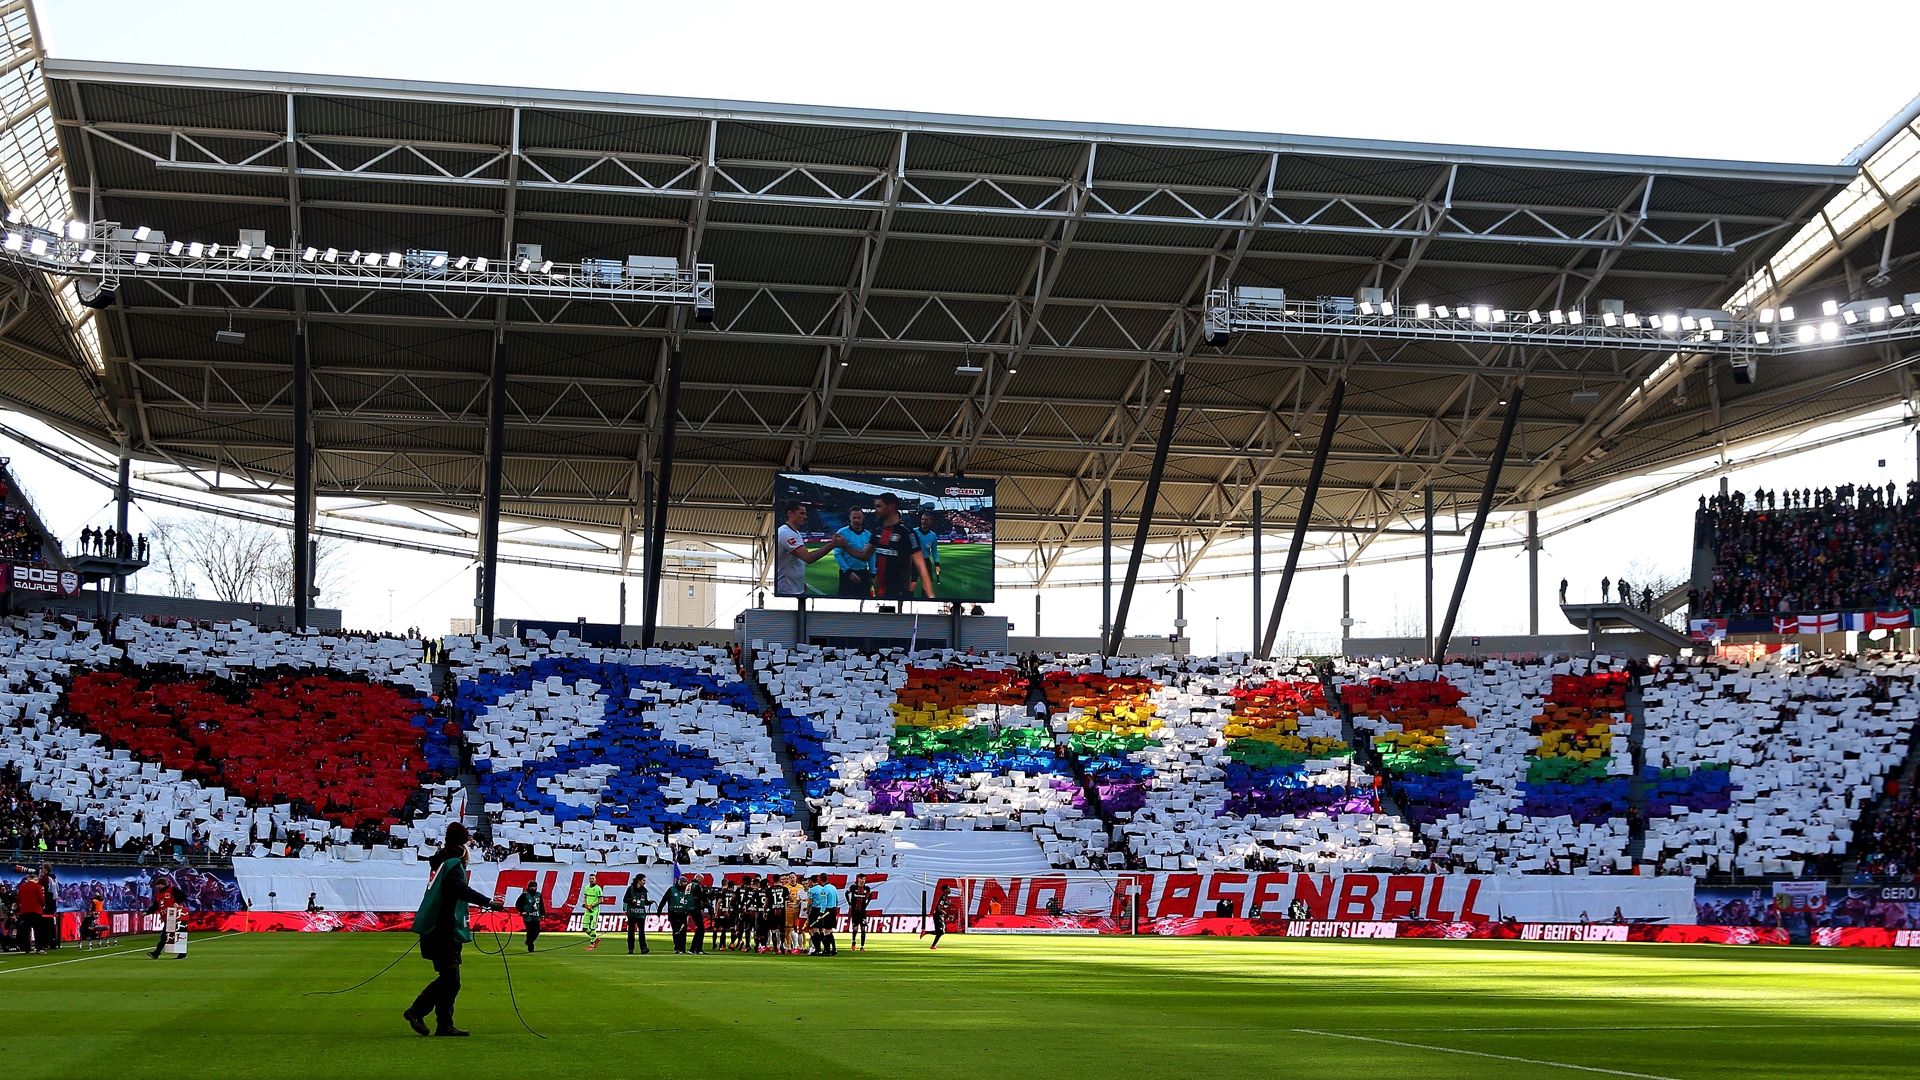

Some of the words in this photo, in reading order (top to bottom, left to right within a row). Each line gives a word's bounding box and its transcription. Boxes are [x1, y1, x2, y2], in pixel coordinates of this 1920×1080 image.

[13, 566, 58, 583] BOS
[14, 581, 58, 593] GAURUS
[466, 870, 630, 912] OVE
[1111, 873, 1490, 922] RASENBALL
[772, 892, 784, 904] 13
[1881, 887, 1917, 900] GERO
[1287, 921, 1310, 937] AUF
[1310, 921, 1351, 938] GEHT'S
[1521, 924, 1544, 940] AUF
[1543, 925, 1584, 941] GEHT'S
